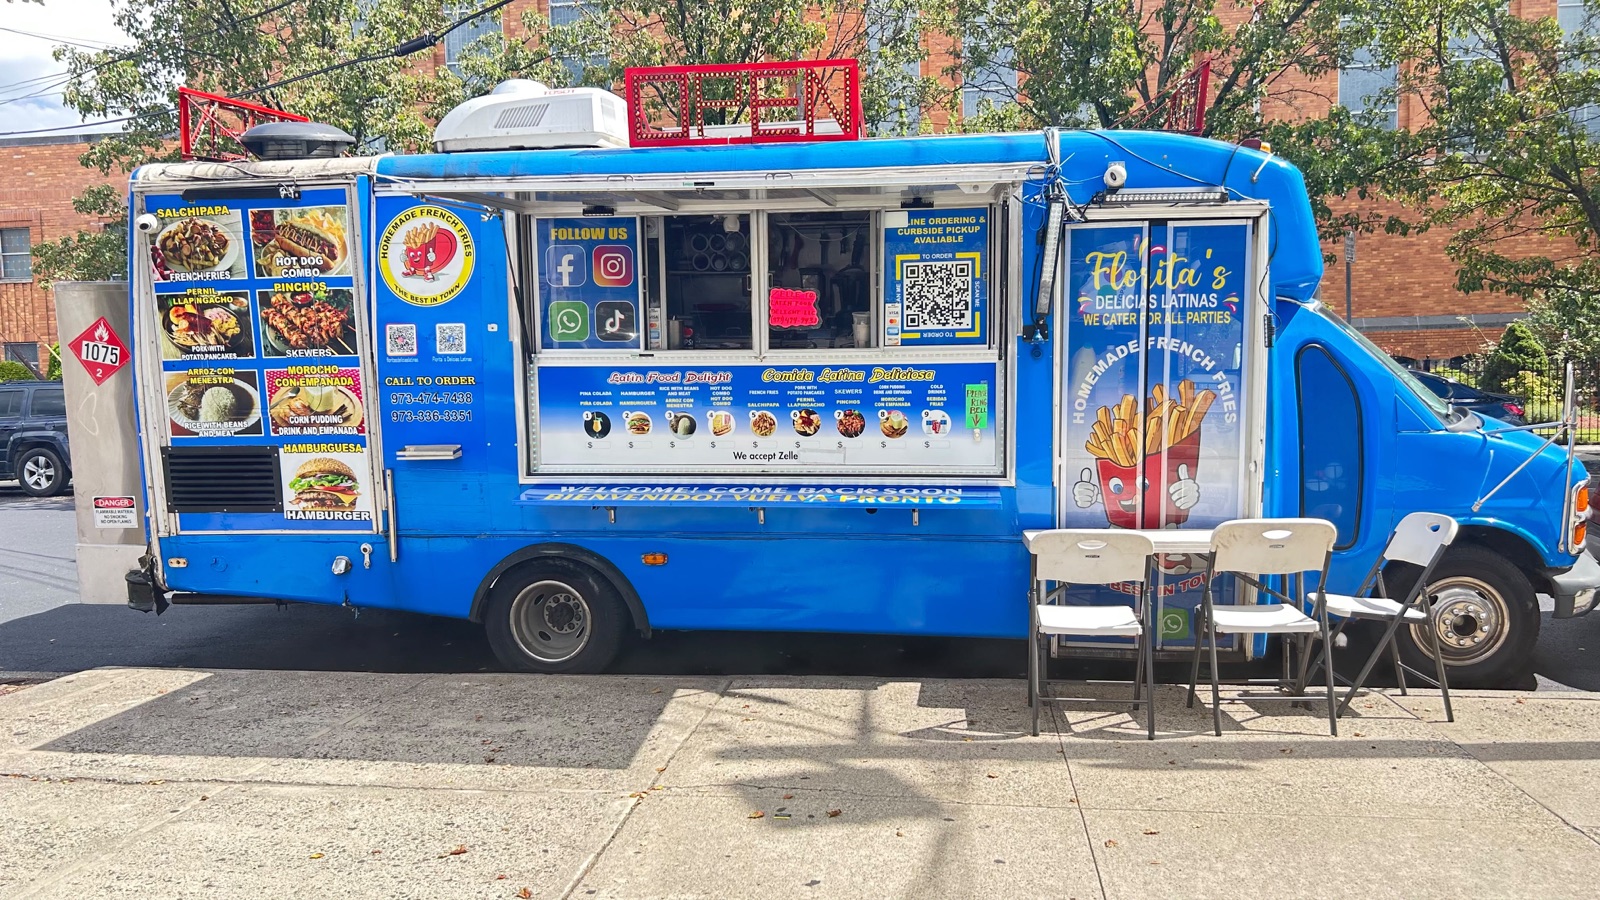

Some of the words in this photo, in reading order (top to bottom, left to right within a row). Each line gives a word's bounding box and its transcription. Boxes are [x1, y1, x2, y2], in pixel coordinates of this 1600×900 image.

[632, 66, 851, 139] OPEN
[157, 206, 230, 218] SALCHIPAPA
[928, 216, 976, 225] ORDERING
[381, 211, 417, 259] HOMEMADE
[420, 209, 459, 227] FRENCH
[457, 227, 472, 257] FRIES
[551, 227, 605, 240] FOLLOW
[608, 227, 628, 240] US
[897, 227, 944, 235] CURBSIDE
[946, 226, 980, 234] PICKUP
[914, 235, 964, 244] AVALIABLE
[276, 257, 297, 266] HOT
[301, 257, 323, 265] DOG
[170, 272, 203, 281] FRENCH
[206, 271, 231, 280] FRIES
[282, 268, 320, 277] COMBO
[274, 282, 327, 291] PINCHOS
[394, 283, 408, 299] THE
[410, 294, 429, 304] BEST
[440, 283, 460, 299] TOWN
[173, 296, 233, 305] LLAPINGACHO
[1095, 294, 1157, 310] DELICIAS
[1161, 294, 1218, 308] LATINAS
[1083, 313, 1100, 326] WE
[1102, 313, 1137, 325] CATER
[1140, 312, 1162, 325] FOR
[1164, 312, 1184, 324] ALL
[1186, 311, 1231, 324] PARTIES
[84, 342, 119, 364] 1075
[286, 349, 331, 357] SKEWERS
[96, 368, 103, 377] 2
[287, 366, 339, 374] MOROCHO
[762, 368, 814, 382] Comida
[817, 368, 866, 383] Latina
[868, 367, 936, 383] Deliciosa
[275, 378, 296, 387] CON
[300, 377, 354, 386] EMPANADA
[385, 377, 414, 385] CALL
[416, 376, 433, 385] TO
[434, 376, 476, 385] ORDER
[608, 372, 644, 384] Latin
[646, 373, 682, 384] Food
[683, 372, 733, 384] Delight
[1073, 340, 1140, 424] HOMEMADE
[1148, 337, 1216, 372] FRENCH
[1212, 371, 1237, 424] FRIES
[391, 393, 473, 405] 973-474-7438
[289, 416, 309, 424] CORN
[311, 415, 343, 423] PUDDING
[391, 410, 473, 422] 973-336-3351
[279, 427, 302, 435] DRINK
[283, 444, 363, 453] HAMBURGUESA
[732, 452, 747, 460] We
[749, 452, 776, 462] accept
[778, 451, 798, 460] Zelle
[543, 493, 723, 501] BIENVENIDO!
[734, 494, 828, 502] VUELVA
[839, 495, 961, 504] PRONTO
[286, 511, 370, 521] HAMBURGER
[1110, 582, 1154, 596] BES
[1157, 584, 1175, 597] IN
